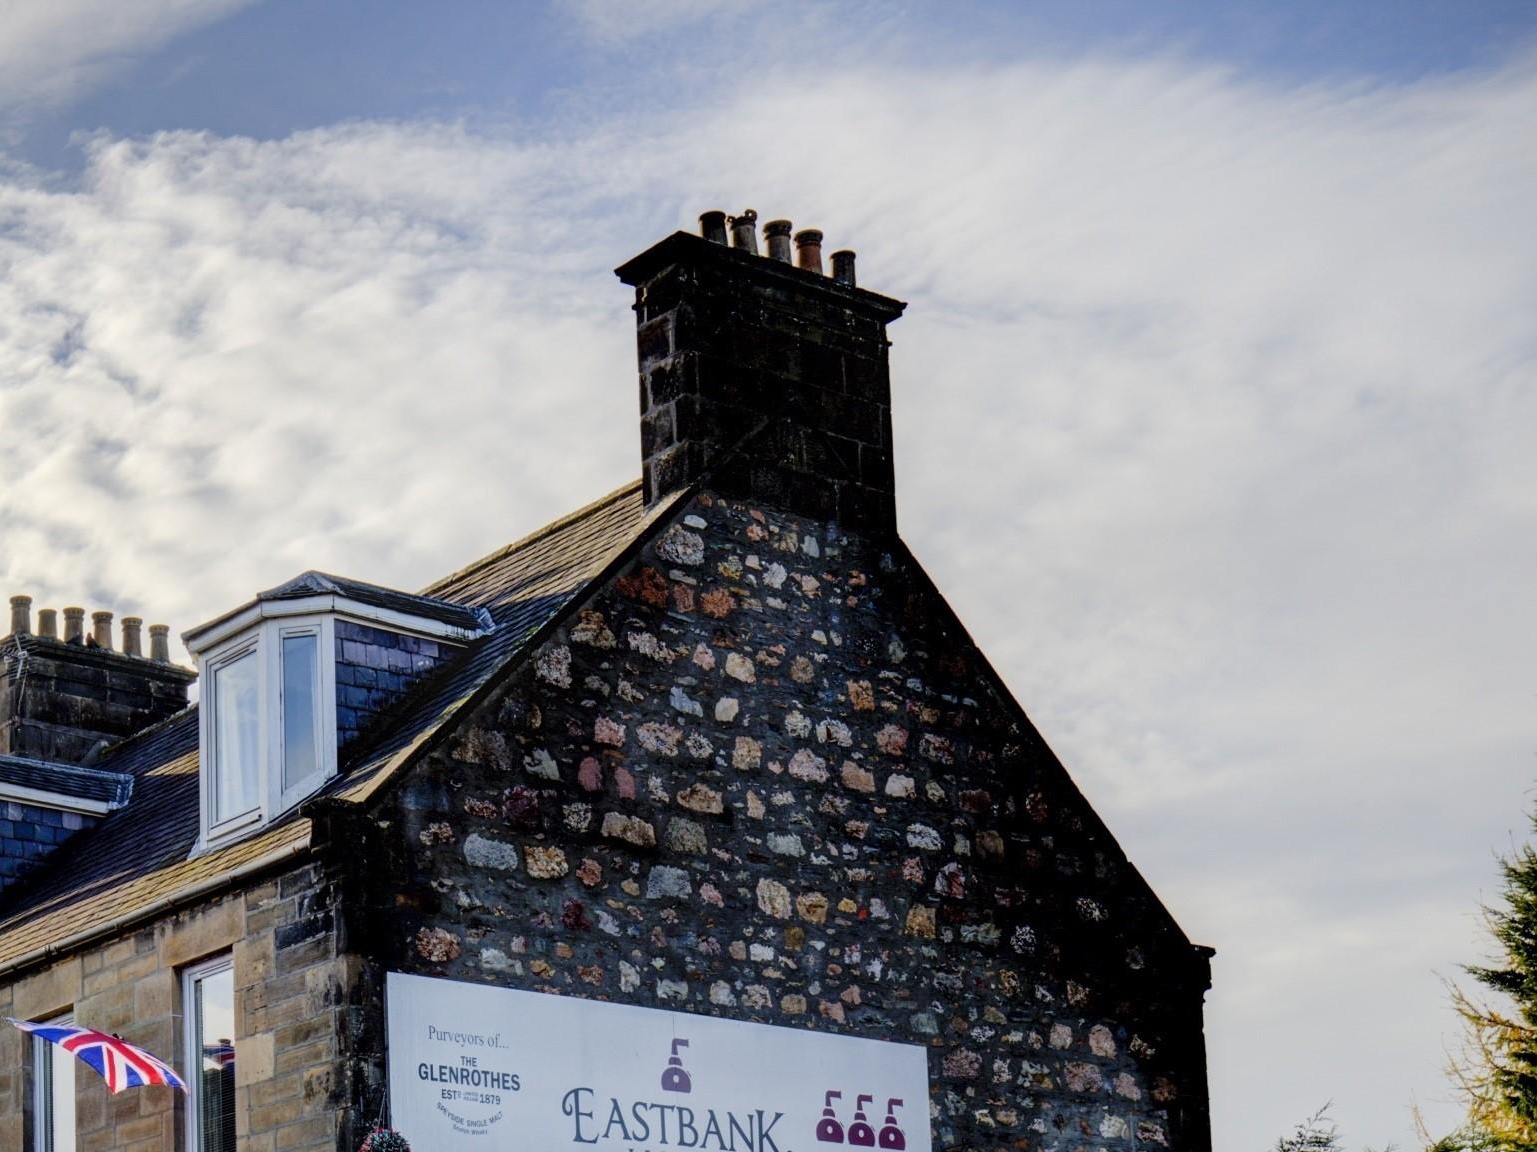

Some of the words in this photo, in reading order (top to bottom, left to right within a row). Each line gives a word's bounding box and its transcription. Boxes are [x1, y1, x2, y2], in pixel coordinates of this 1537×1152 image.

[428, 1025, 485, 1048] Purveyors
[460, 1055, 478, 1067] THE
[418, 1062, 521, 1092] GLENROTHES
[479, 1093, 501, 1105] 1879
[466, 1119, 488, 1128] SINGLE
